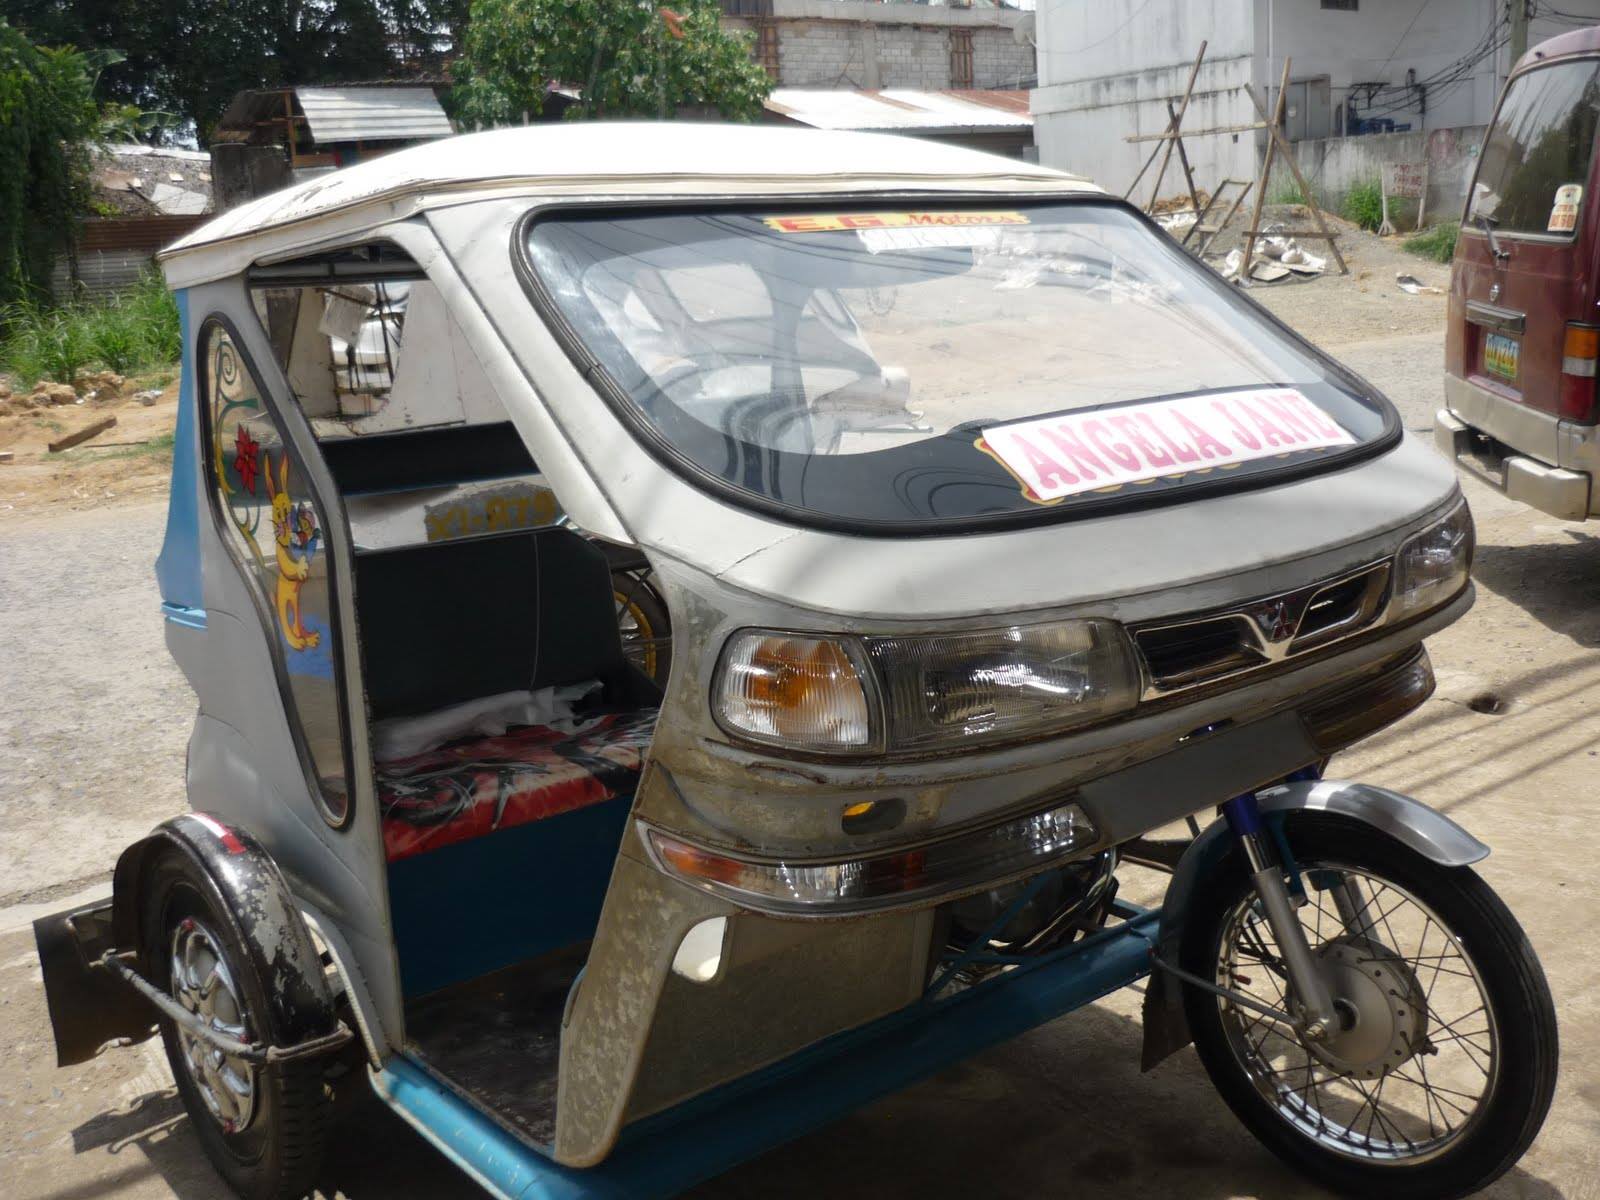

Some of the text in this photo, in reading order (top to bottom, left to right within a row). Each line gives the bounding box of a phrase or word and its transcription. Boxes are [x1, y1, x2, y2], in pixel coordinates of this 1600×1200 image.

[907, 212, 1017, 225] Motors
[1011, 395, 1340, 490] ANGELA JANE
